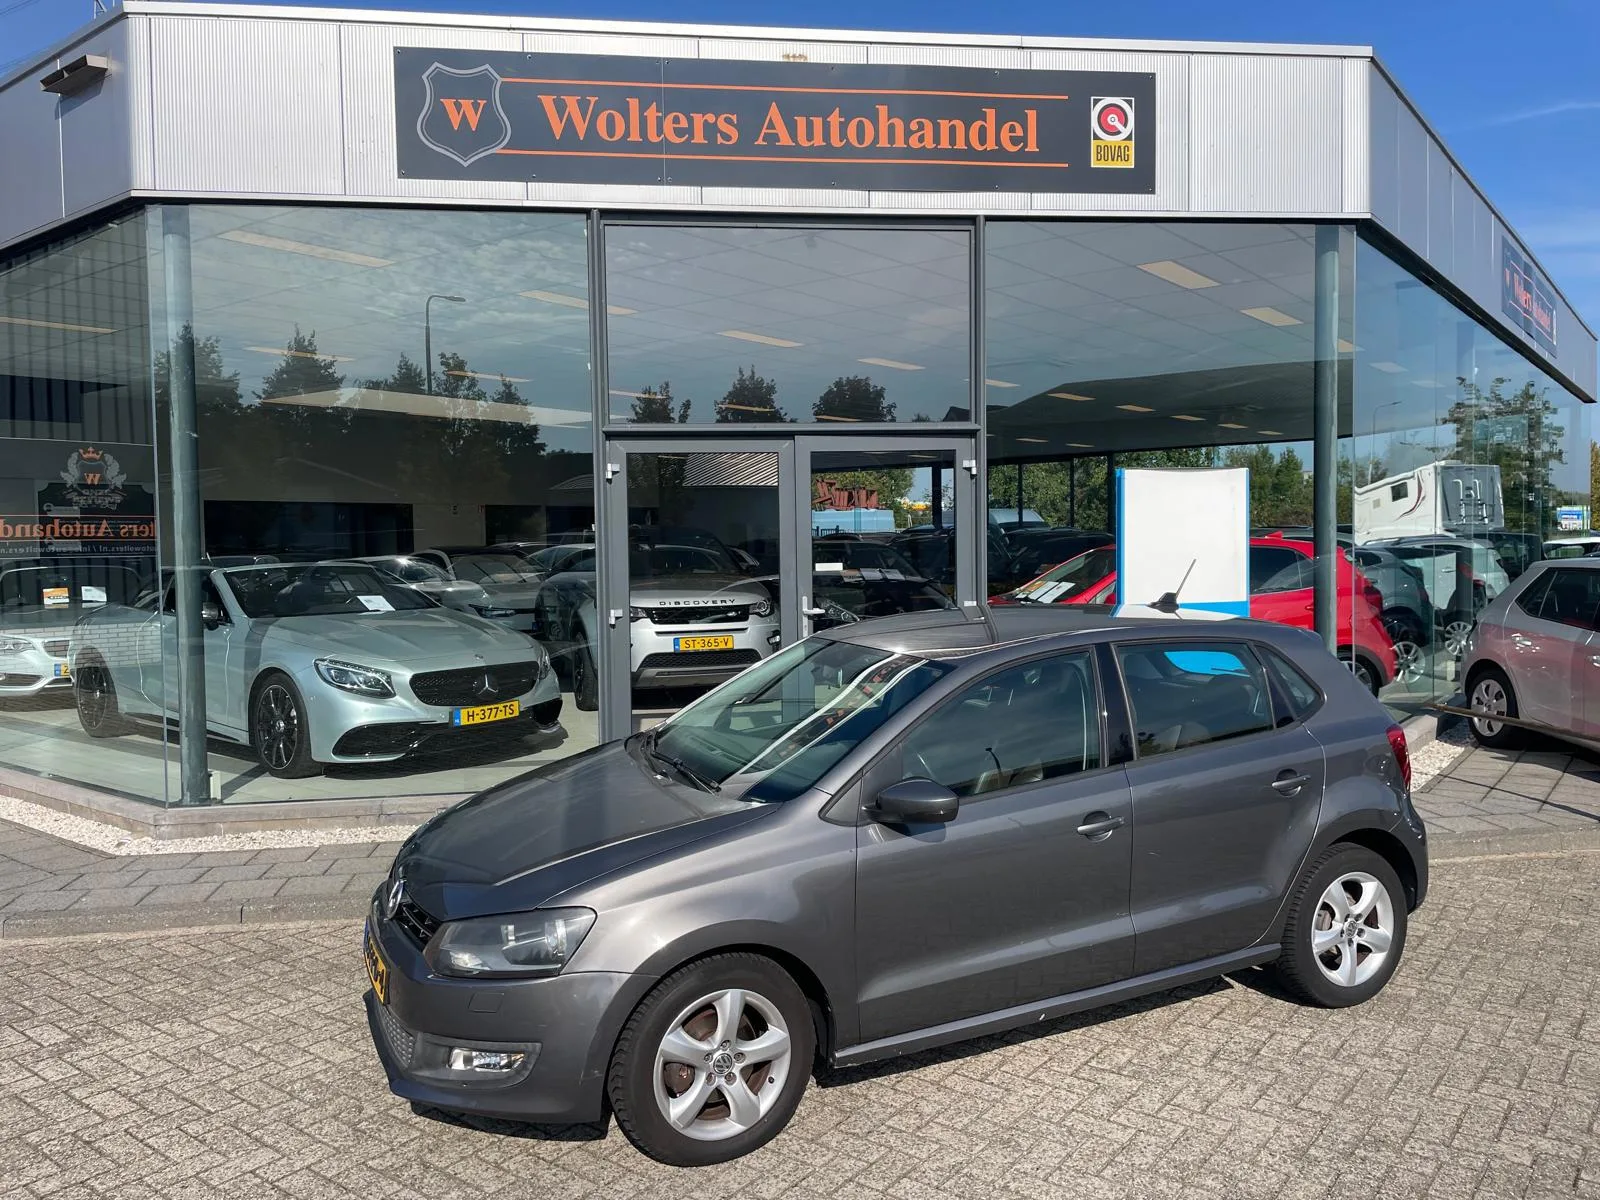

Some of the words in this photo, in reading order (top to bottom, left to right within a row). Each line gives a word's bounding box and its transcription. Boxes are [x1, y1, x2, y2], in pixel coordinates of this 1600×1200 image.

[440, 98, 487, 132] W
[537, 95, 739, 144] Wolters
[754, 101, 1039, 152] Autohandel
[1096, 144, 1130, 162] BOVAG
[684, 638, 729, 649] ST-365-V
[467, 704, 515, 722] H-377-TS
